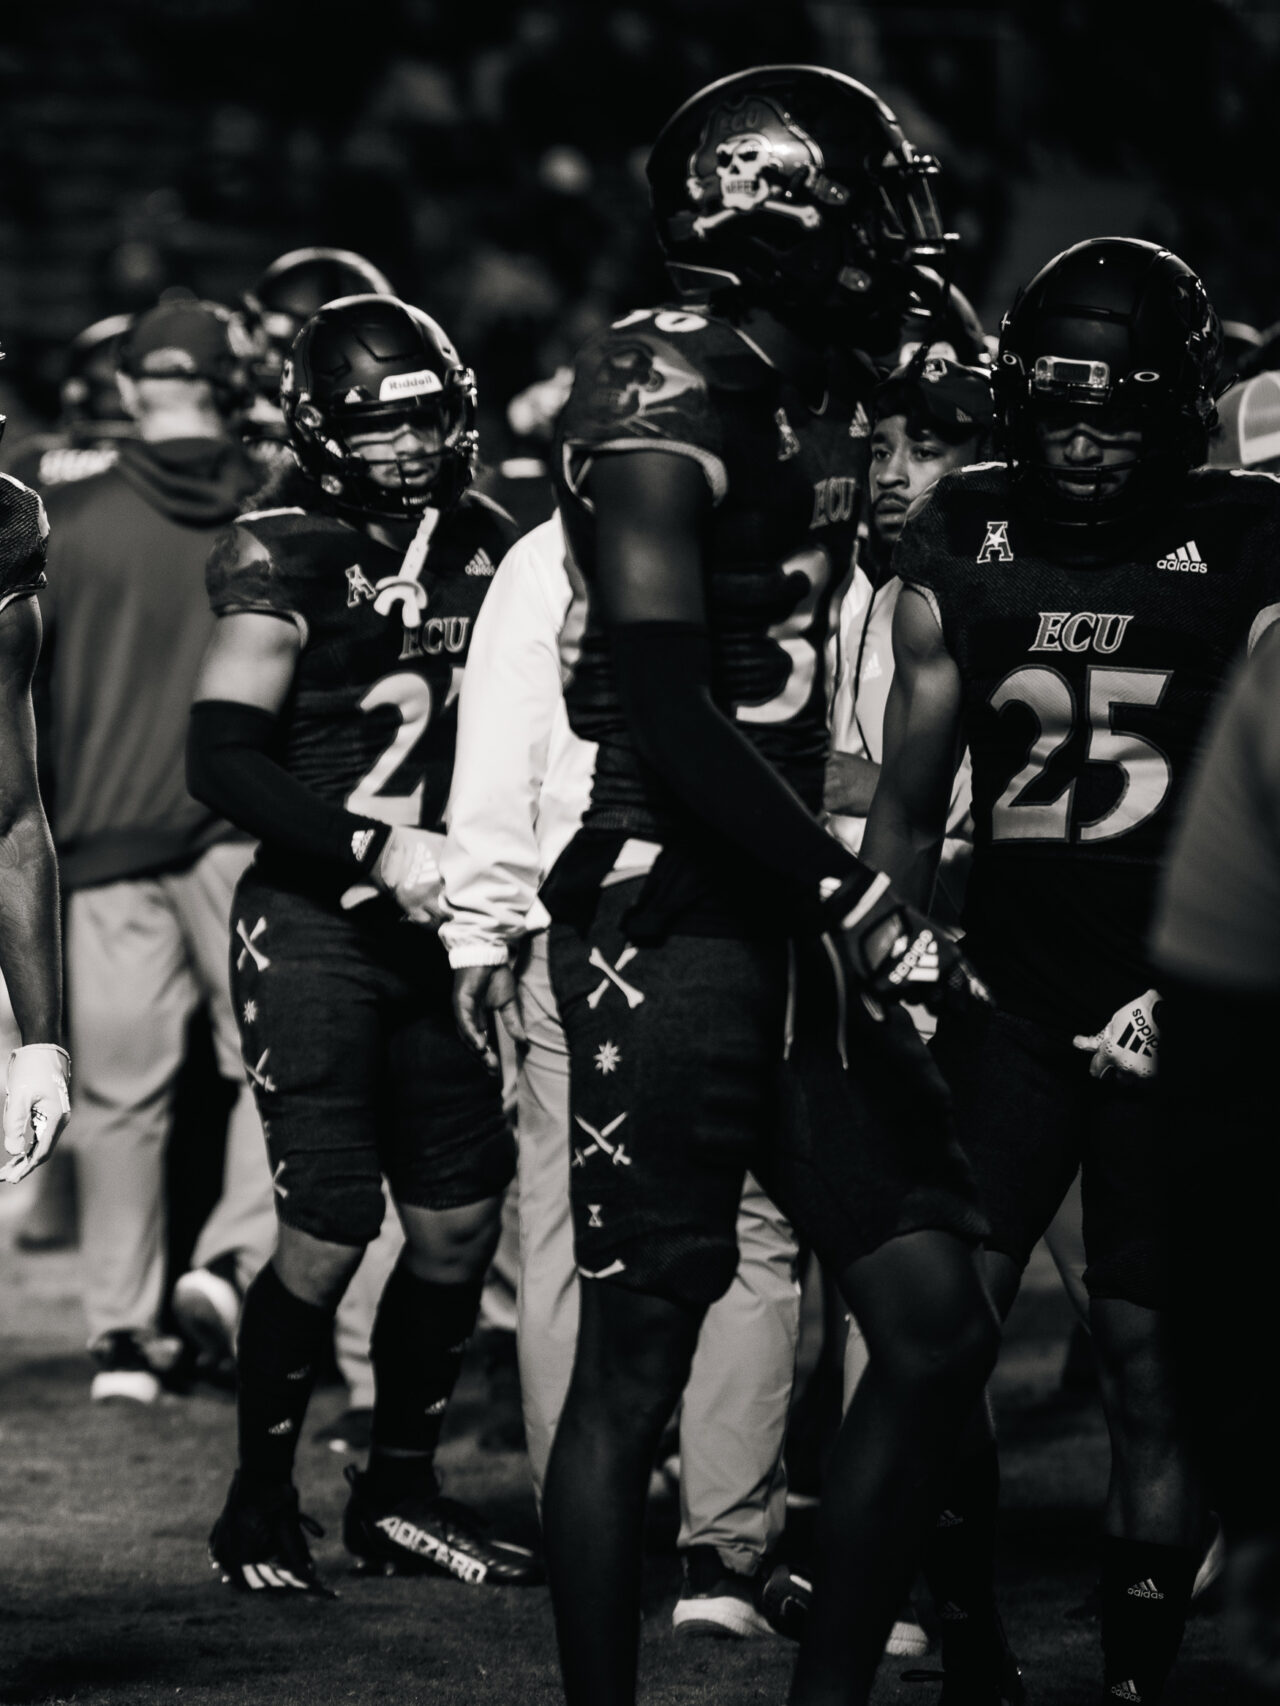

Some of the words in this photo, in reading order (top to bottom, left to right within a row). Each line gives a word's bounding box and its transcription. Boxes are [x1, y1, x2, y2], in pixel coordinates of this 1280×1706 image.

[1156, 558, 1208, 574] adidas
[397, 616, 471, 661] ECU
[1027, 611, 1135, 655] ECU
[344, 668, 467, 828] 2
[986, 662, 1175, 844] 25
[1132, 1008, 1160, 1049] adidas
[1127, 1587, 1165, 1600] adidas
[1111, 1686, 1142, 1704] adidas
